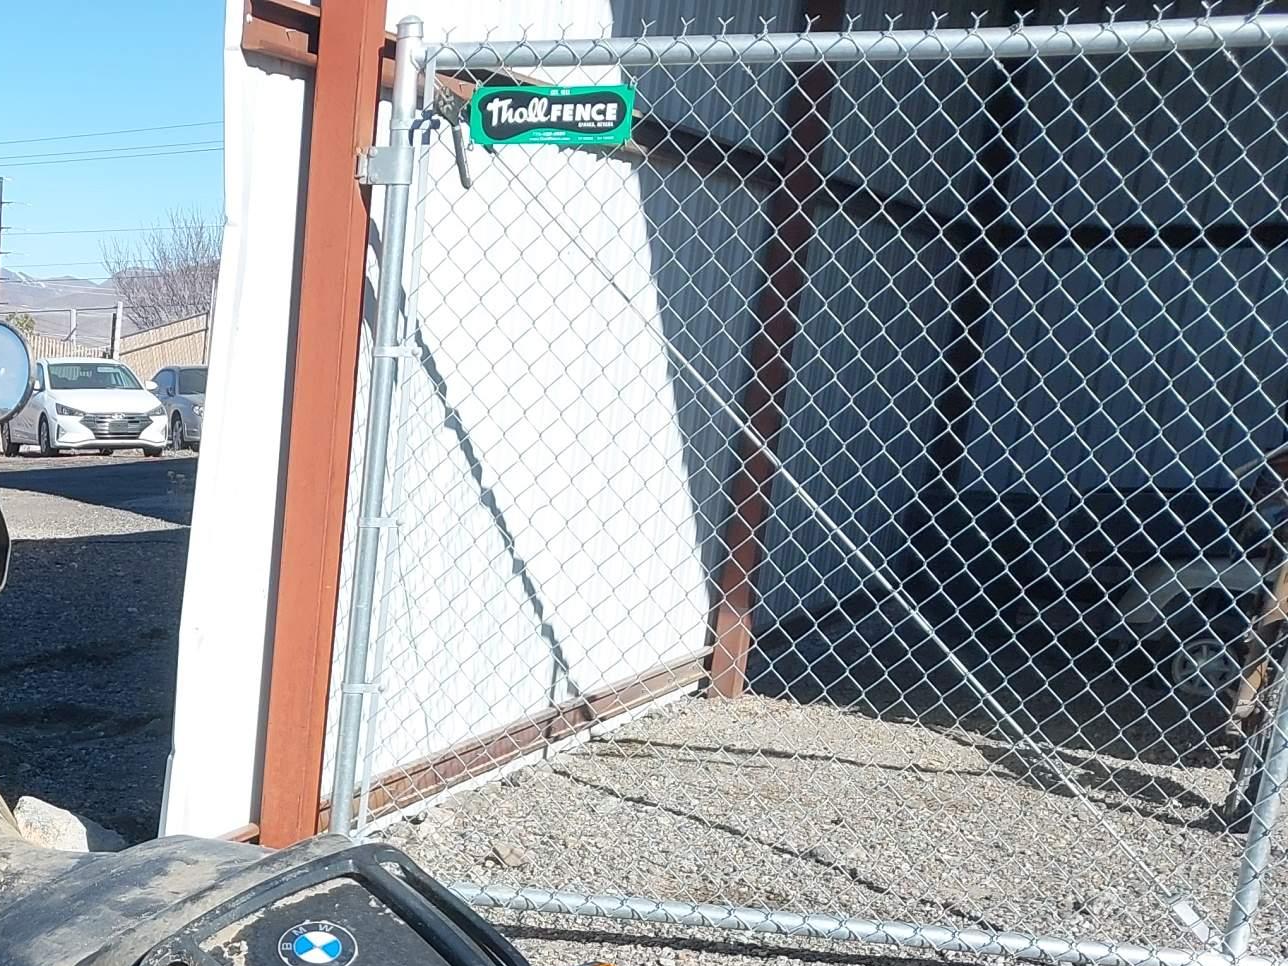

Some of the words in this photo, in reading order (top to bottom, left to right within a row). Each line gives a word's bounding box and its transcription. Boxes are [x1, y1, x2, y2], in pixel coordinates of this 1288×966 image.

[486, 97, 551, 127] Tholl
[550, 103, 618, 121] FENCE
[281, 924, 334, 951] BMW
